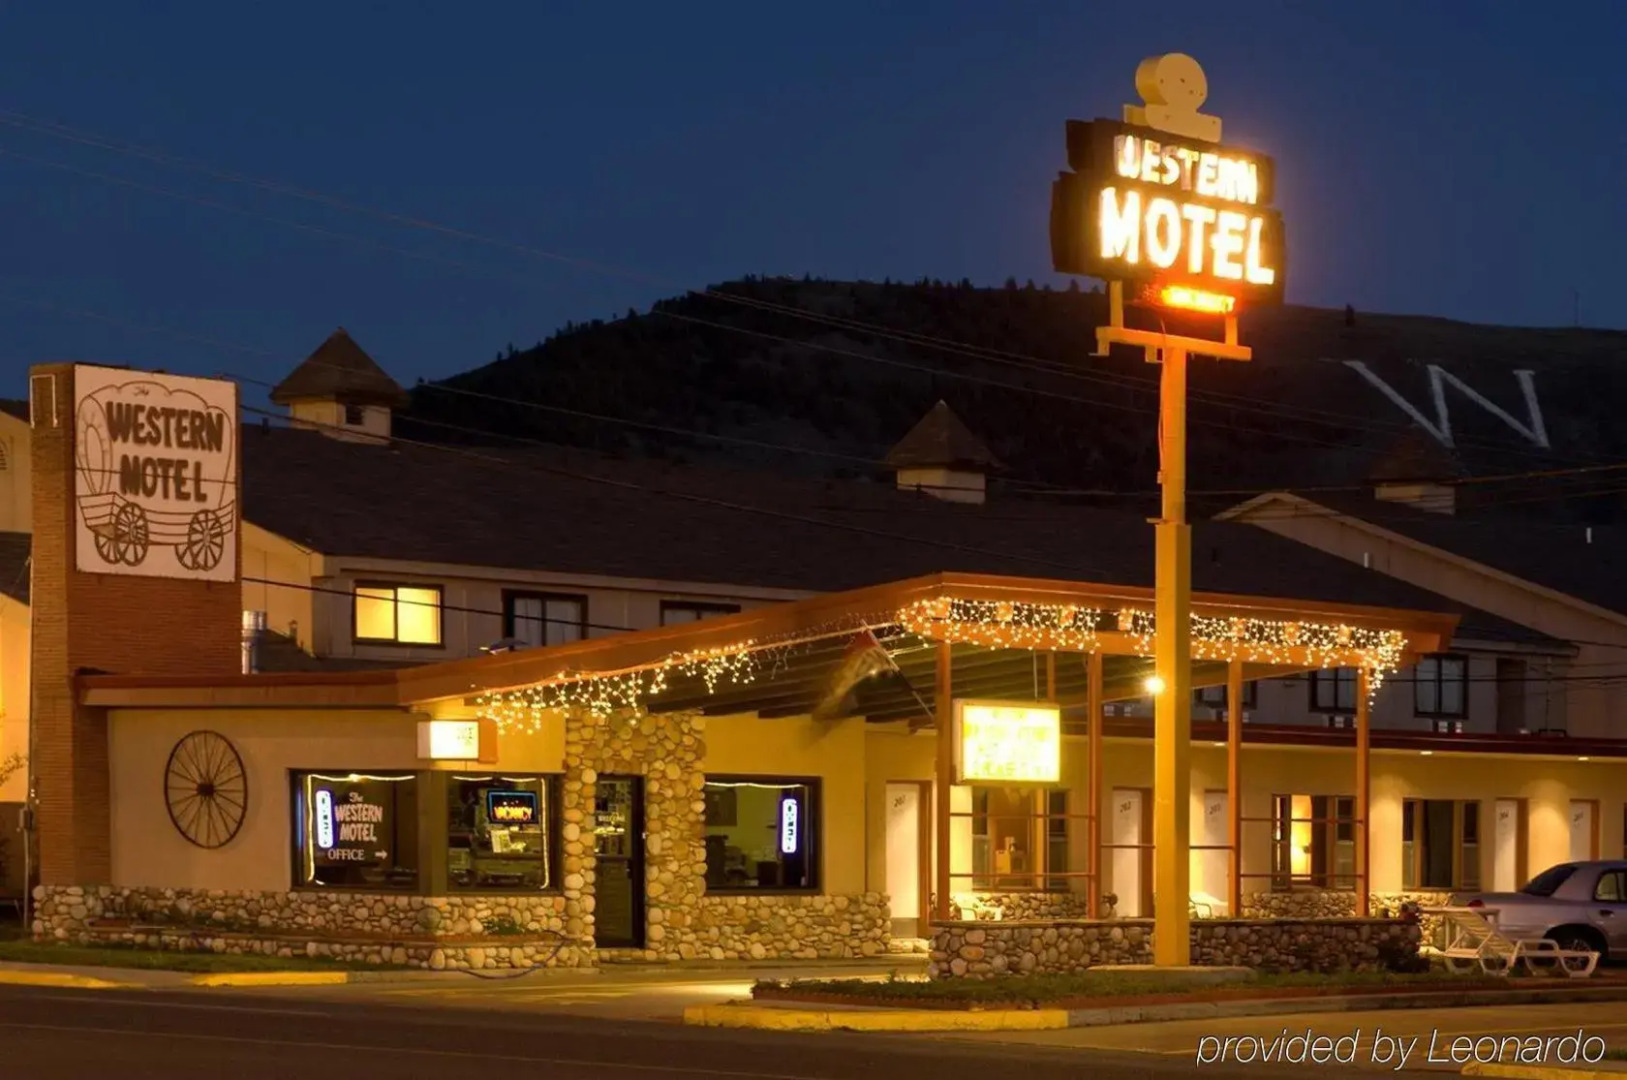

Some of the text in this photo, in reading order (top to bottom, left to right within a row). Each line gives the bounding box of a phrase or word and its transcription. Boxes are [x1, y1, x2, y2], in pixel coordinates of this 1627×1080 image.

[1113, 134, 1258, 204] WESTERN
[1101, 187, 1275, 285] MOTEL
[105, 400, 224, 453] WESTERN
[119, 453, 208, 503] MOTEL
[334, 803, 383, 822] WESTERN
[340, 823, 377, 842] MOTEL
[327, 848, 365, 860] OFFICE
